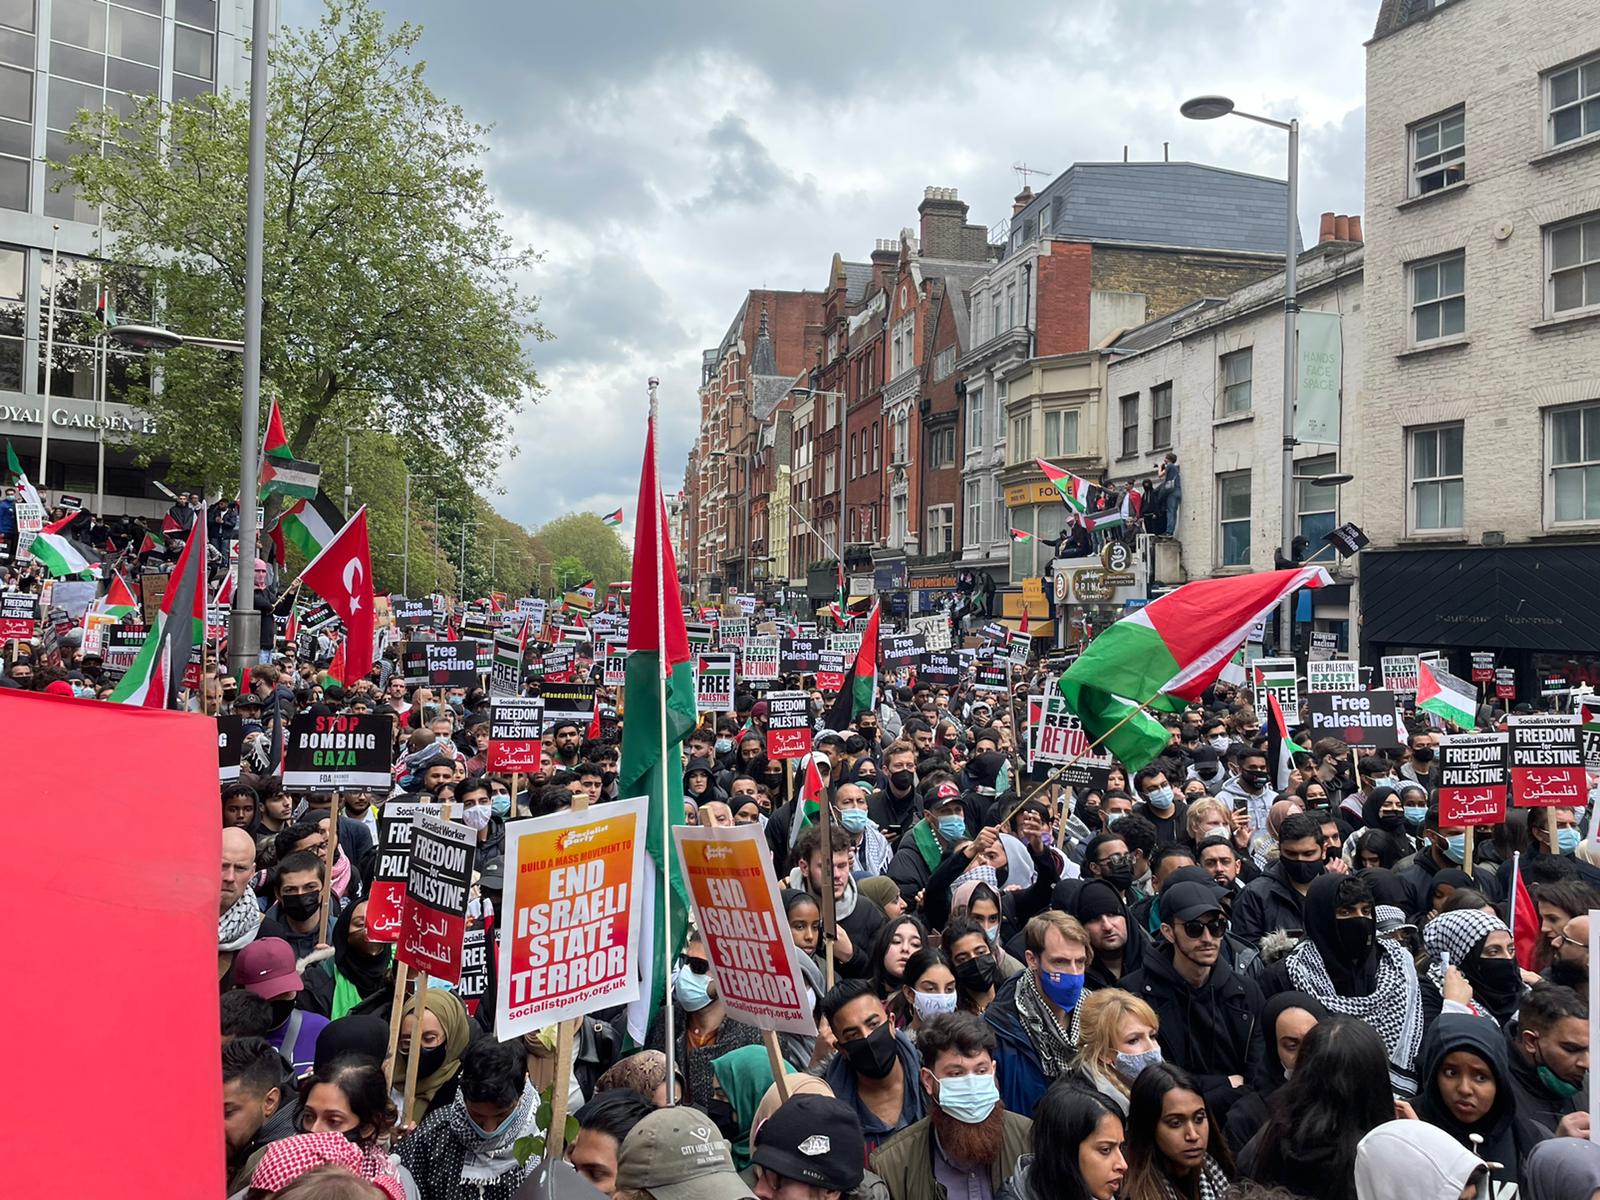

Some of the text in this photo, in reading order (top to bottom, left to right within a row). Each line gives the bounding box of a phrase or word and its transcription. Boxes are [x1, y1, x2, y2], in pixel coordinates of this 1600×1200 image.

[1303, 351, 1335, 364] HANDS
[1307, 364, 1331, 377] FACE
[1303, 378, 1334, 391] SPACE
[4, 599, 33, 607] FREEDOM
[2, 610, 34, 619] PALESTINE
[397, 609, 433, 618] Palestine
[426, 644, 457, 657] Free
[595, 643, 605, 651] FR
[746, 647, 777, 655] EXIST!
[792, 641, 812, 650] Free
[893, 639, 914, 650] Free
[782, 650, 818, 661] Palestin
[820, 655, 843, 663] FREEDOM
[885, 645, 926, 659] Palestine
[428, 658, 474, 671] lestine
[931, 655, 948, 664] Free
[492, 662, 518, 683] FREE
[745, 662, 776, 676] RETURN!
[819, 663, 843, 672] PALESTINE
[921, 663, 959, 676] Palestine
[1311, 663, 1355, 672] FREE PALESTINE
[698, 675, 730, 693] FREE
[1312, 673, 1355, 682] EXIST!
[1386, 678, 1417, 689] RETURN!
[492, 678, 517, 692] PALESTINE
[698, 694, 730, 702] PALESTINE
[1331, 695, 1370, 711] Free
[771, 700, 806, 711] FREEDOM
[1257, 704, 1297, 712] PATINE
[495, 708, 538, 720] FREEDOM
[1312, 712, 1393, 728] Palestine
[316, 716, 360, 732] STOP
[769, 716, 808, 728] PALESTINE
[492, 726, 539, 738] PALESTINE
[775, 732, 801, 742] الحرية
[1515, 728, 1575, 743] FREEDOM
[299, 733, 375, 750] BOMBING
[499, 743, 530, 754] الحرية
[772, 741, 805, 754] لفلسطين
[1541, 742, 1552, 750] for
[312, 751, 357, 766] GAZA
[494, 754, 534, 767] لفلسطين
[1446, 746, 1501, 763] FREEDOM
[1514, 750, 1580, 765] PALESTINE
[1470, 762, 1480, 770] for
[1442, 769, 1503, 785] PALESTINE
[1526, 771, 1570, 786] الحرية
[1453, 790, 1492, 804] الحرية
[1522, 785, 1578, 800] لفلسطين
[425, 807, 440, 816] Wor
[1447, 804, 1498, 820] لفلسطين
[421, 818, 466, 841] Socialist Worker
[567, 825, 609, 840] Socialist
[414, 834, 467, 873] FREEDOM
[521, 839, 632, 874] BUILD A MASS MOVEMENT TO
[429, 864, 440, 878] for
[549, 859, 605, 900] END
[409, 869, 466, 911] PALESTINE
[707, 879, 746, 907] END
[518, 882, 628, 939] ISRAELI
[412, 907, 448, 936] الحرية
[700, 907, 777, 942] ISRAELI
[529, 916, 614, 968] STATE
[405, 935, 452, 964] لفلسطين
[717, 940, 773, 972] STATE
[511, 945, 626, 1004] TERROR
[717, 966, 799, 1006] TERROR
[509, 979, 627, 1021] socialistparty.org.uk
[726, 1000, 804, 1021] socialistparty.org.uk
[681, 1146, 696, 1156] CITY
